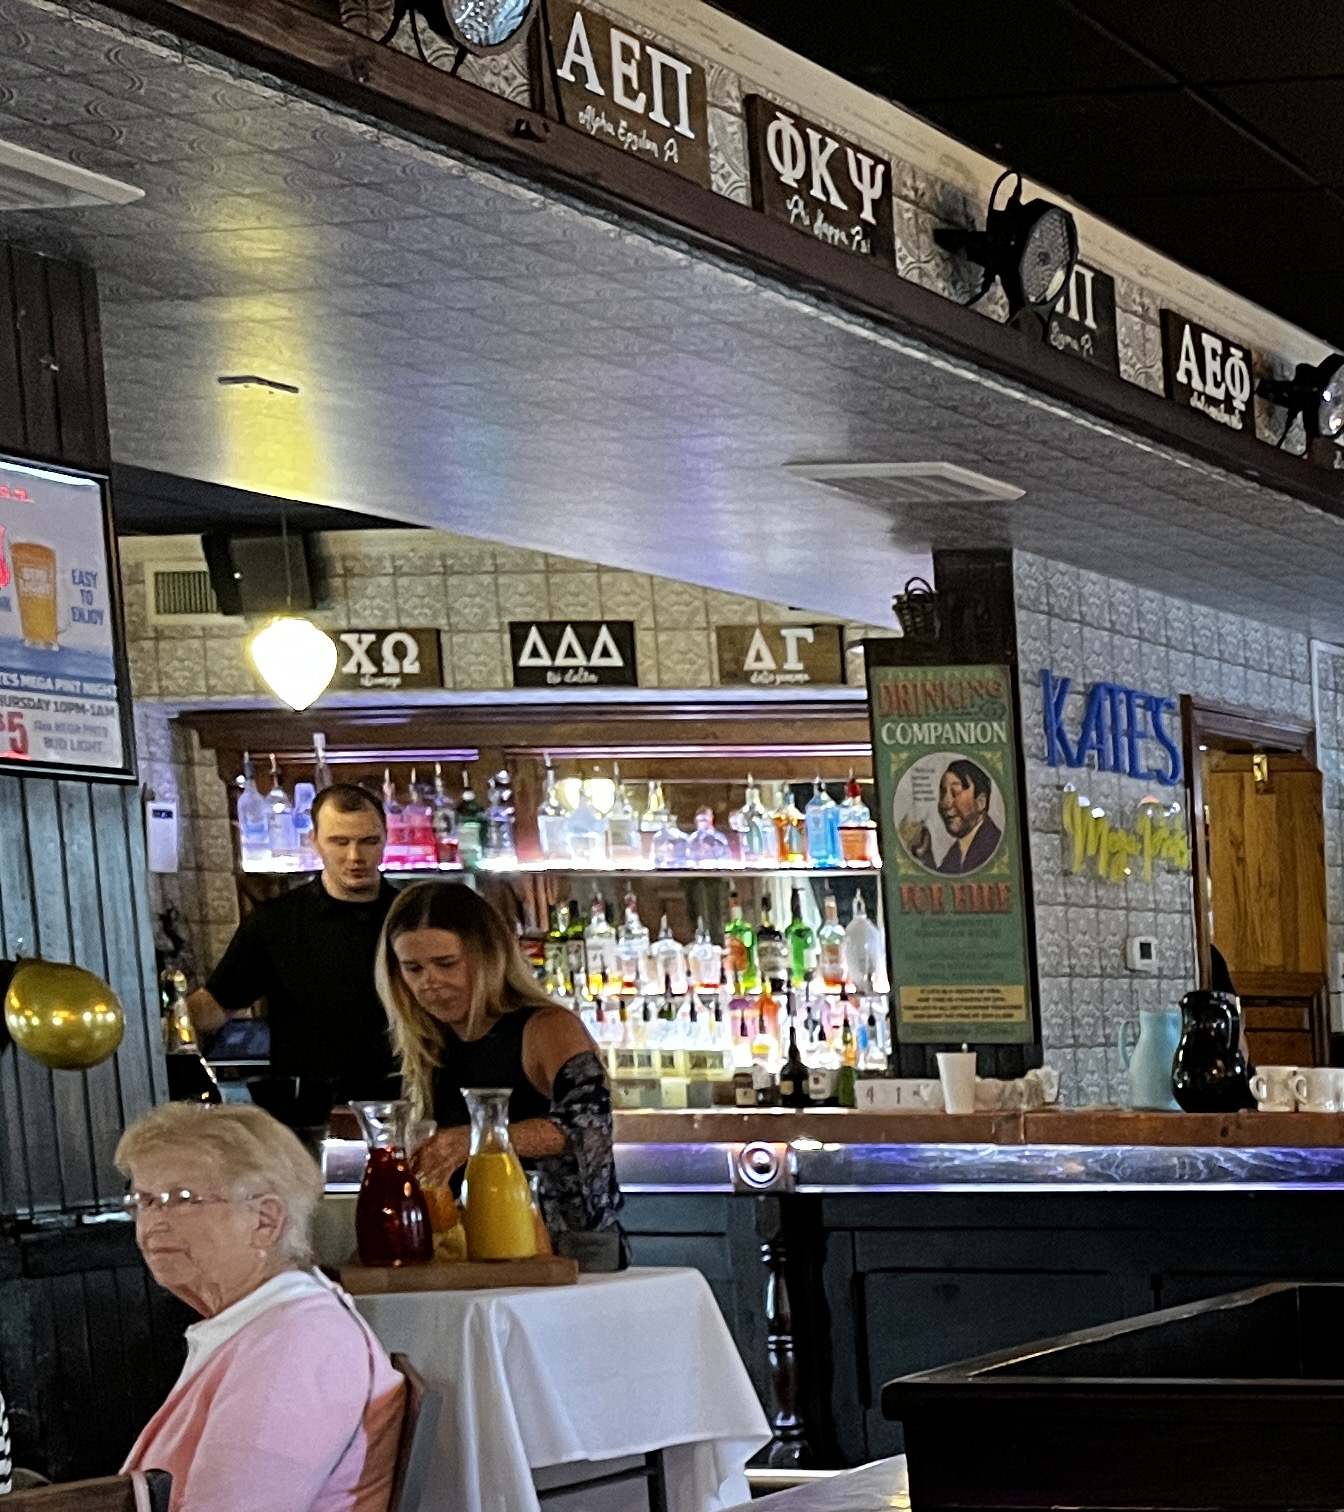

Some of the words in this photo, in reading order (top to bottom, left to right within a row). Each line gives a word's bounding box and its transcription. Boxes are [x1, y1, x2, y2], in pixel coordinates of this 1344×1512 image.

[557, 11, 695, 139] ΑΕΠ
[766, 111, 885, 225] ΦΚΨ
[1176, 324, 1251, 411] ΑΕΦ
[340, 631, 421, 674] ΧΩ
[518, 623, 624, 667] ΔΔΔ
[743, 627, 815, 671] ΔΓ
[881, 720, 1008, 745] COMPANION
